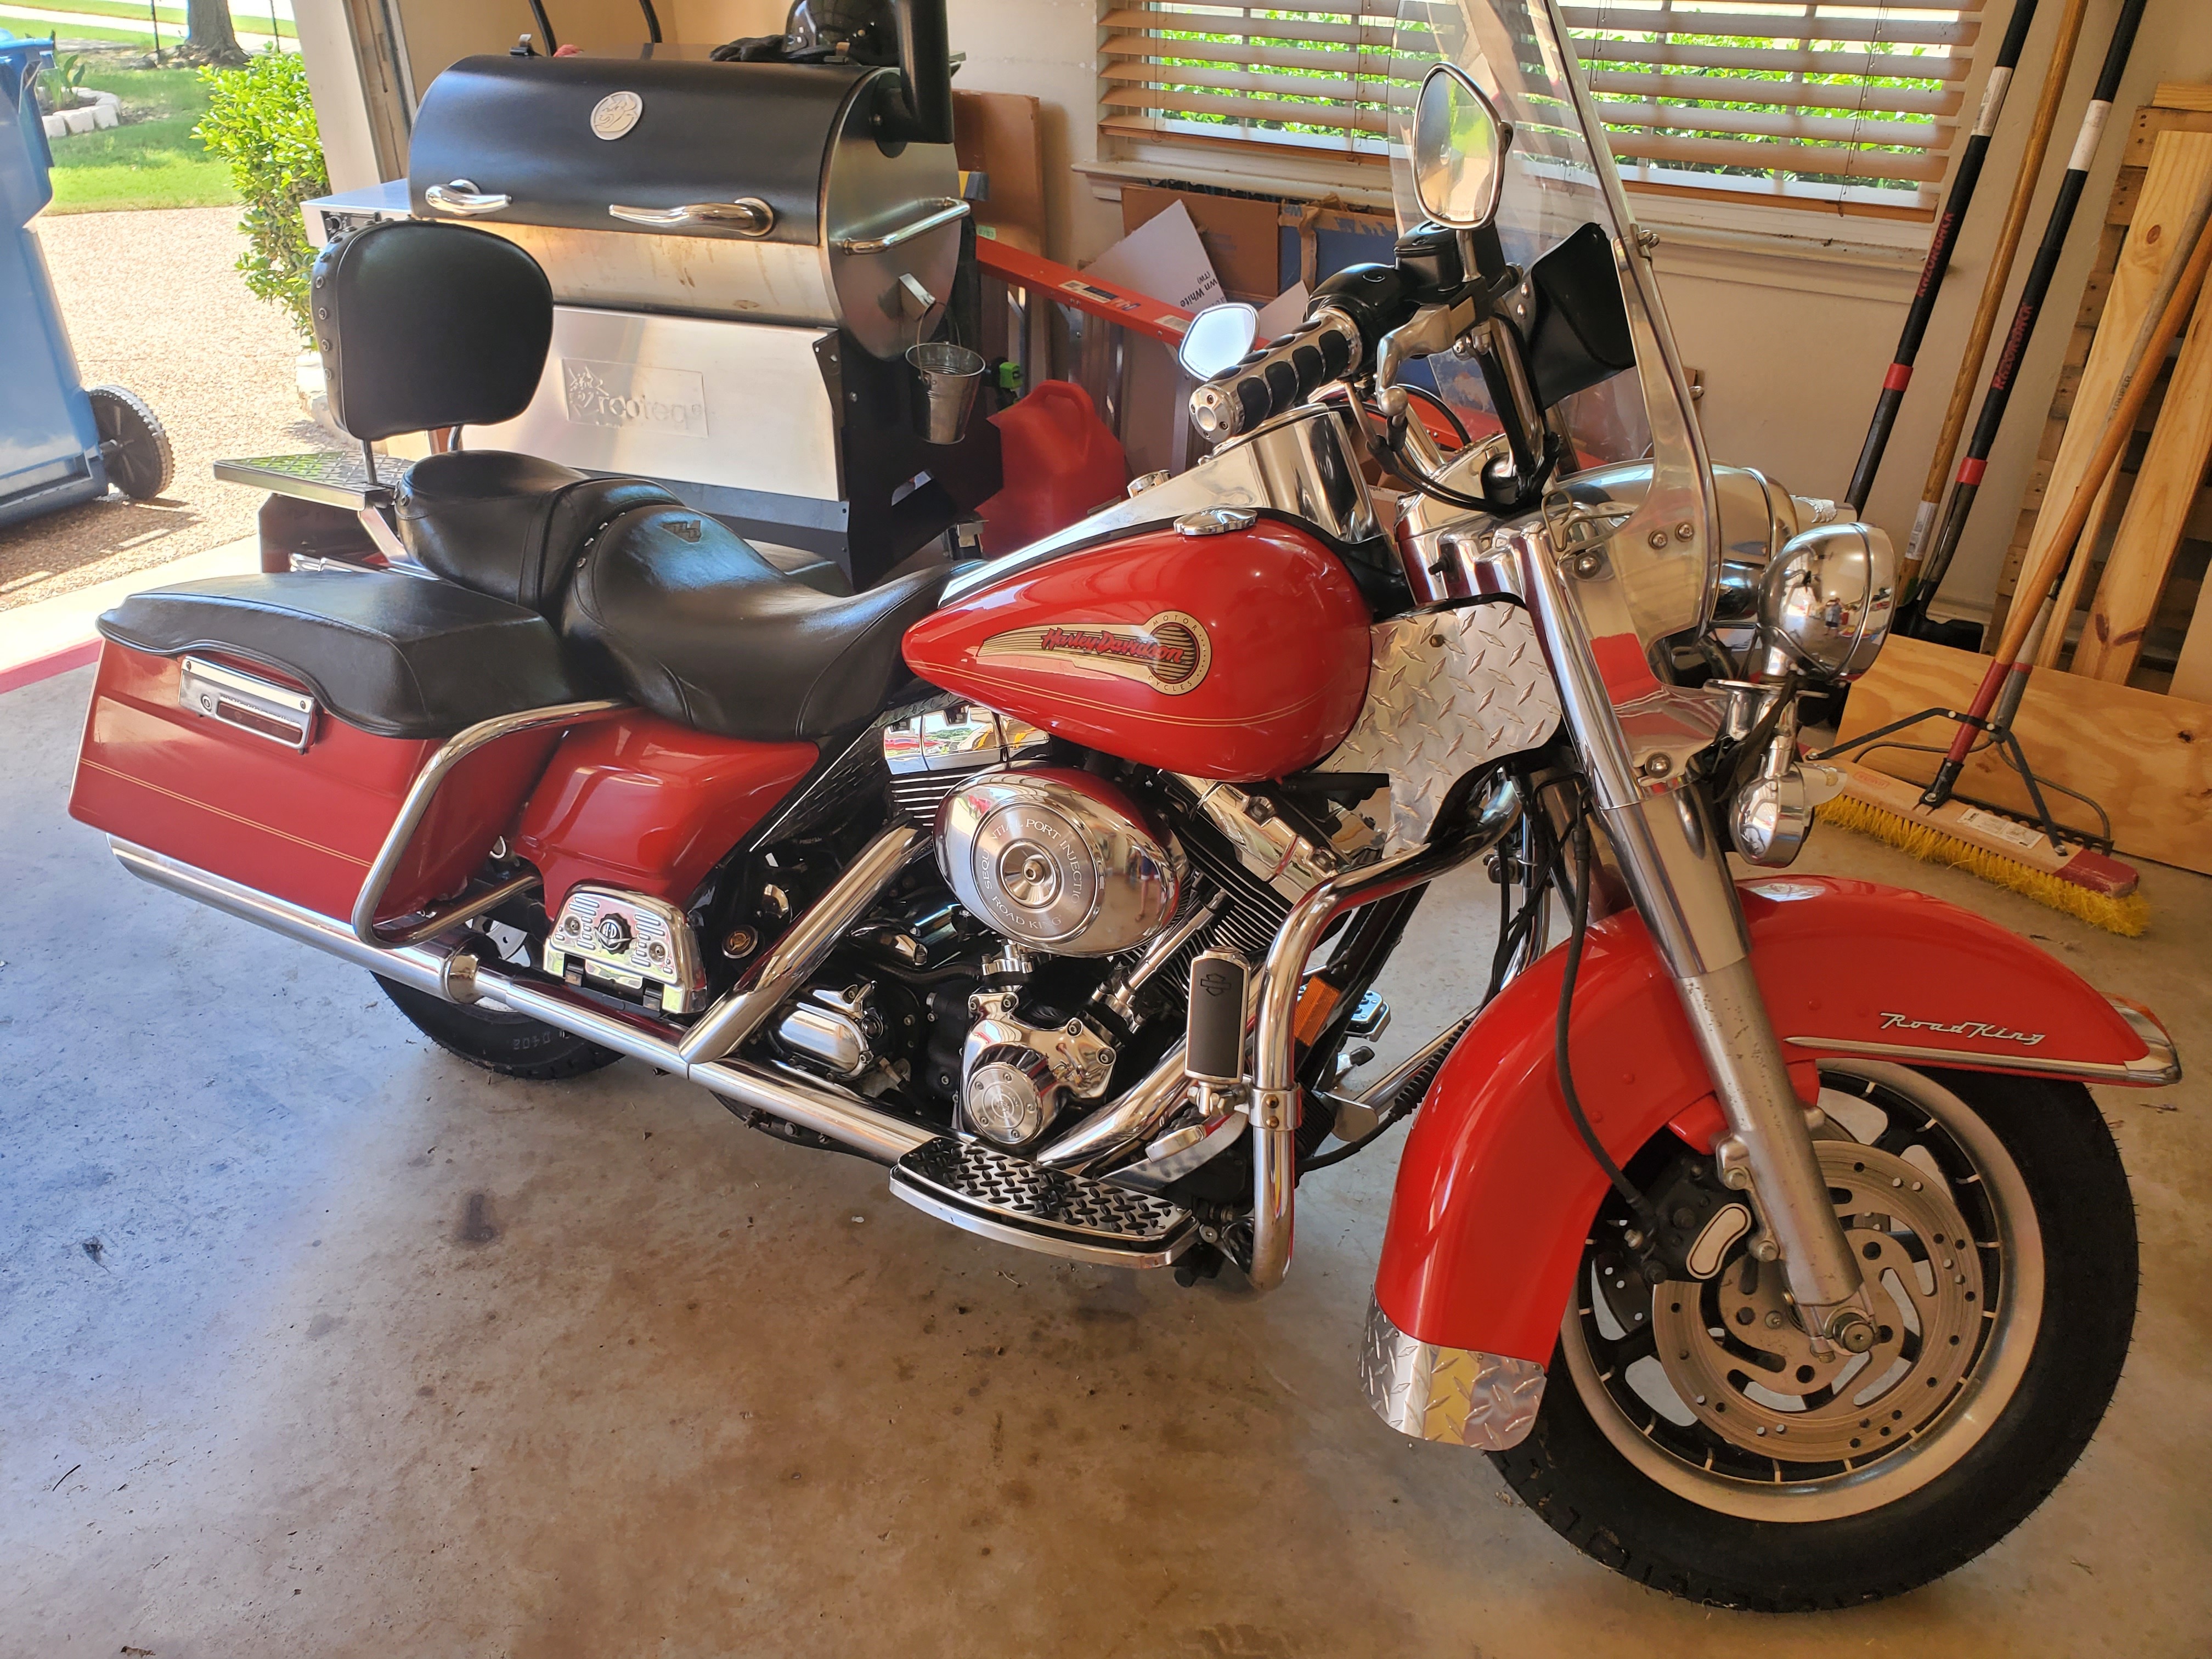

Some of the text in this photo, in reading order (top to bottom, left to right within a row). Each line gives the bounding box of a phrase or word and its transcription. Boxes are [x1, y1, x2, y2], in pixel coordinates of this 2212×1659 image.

[1197, 271, 1210, 285] (TW)
[1180, 288, 1205, 307] White
[1153, 615, 1197, 631] MOTOR
[1148, 675, 1192, 691] CYCLES
[1026, 818, 1061, 840] PORT
[1059, 840, 1082, 906] INJECTIO
[992, 895, 1025, 926] ROAD
